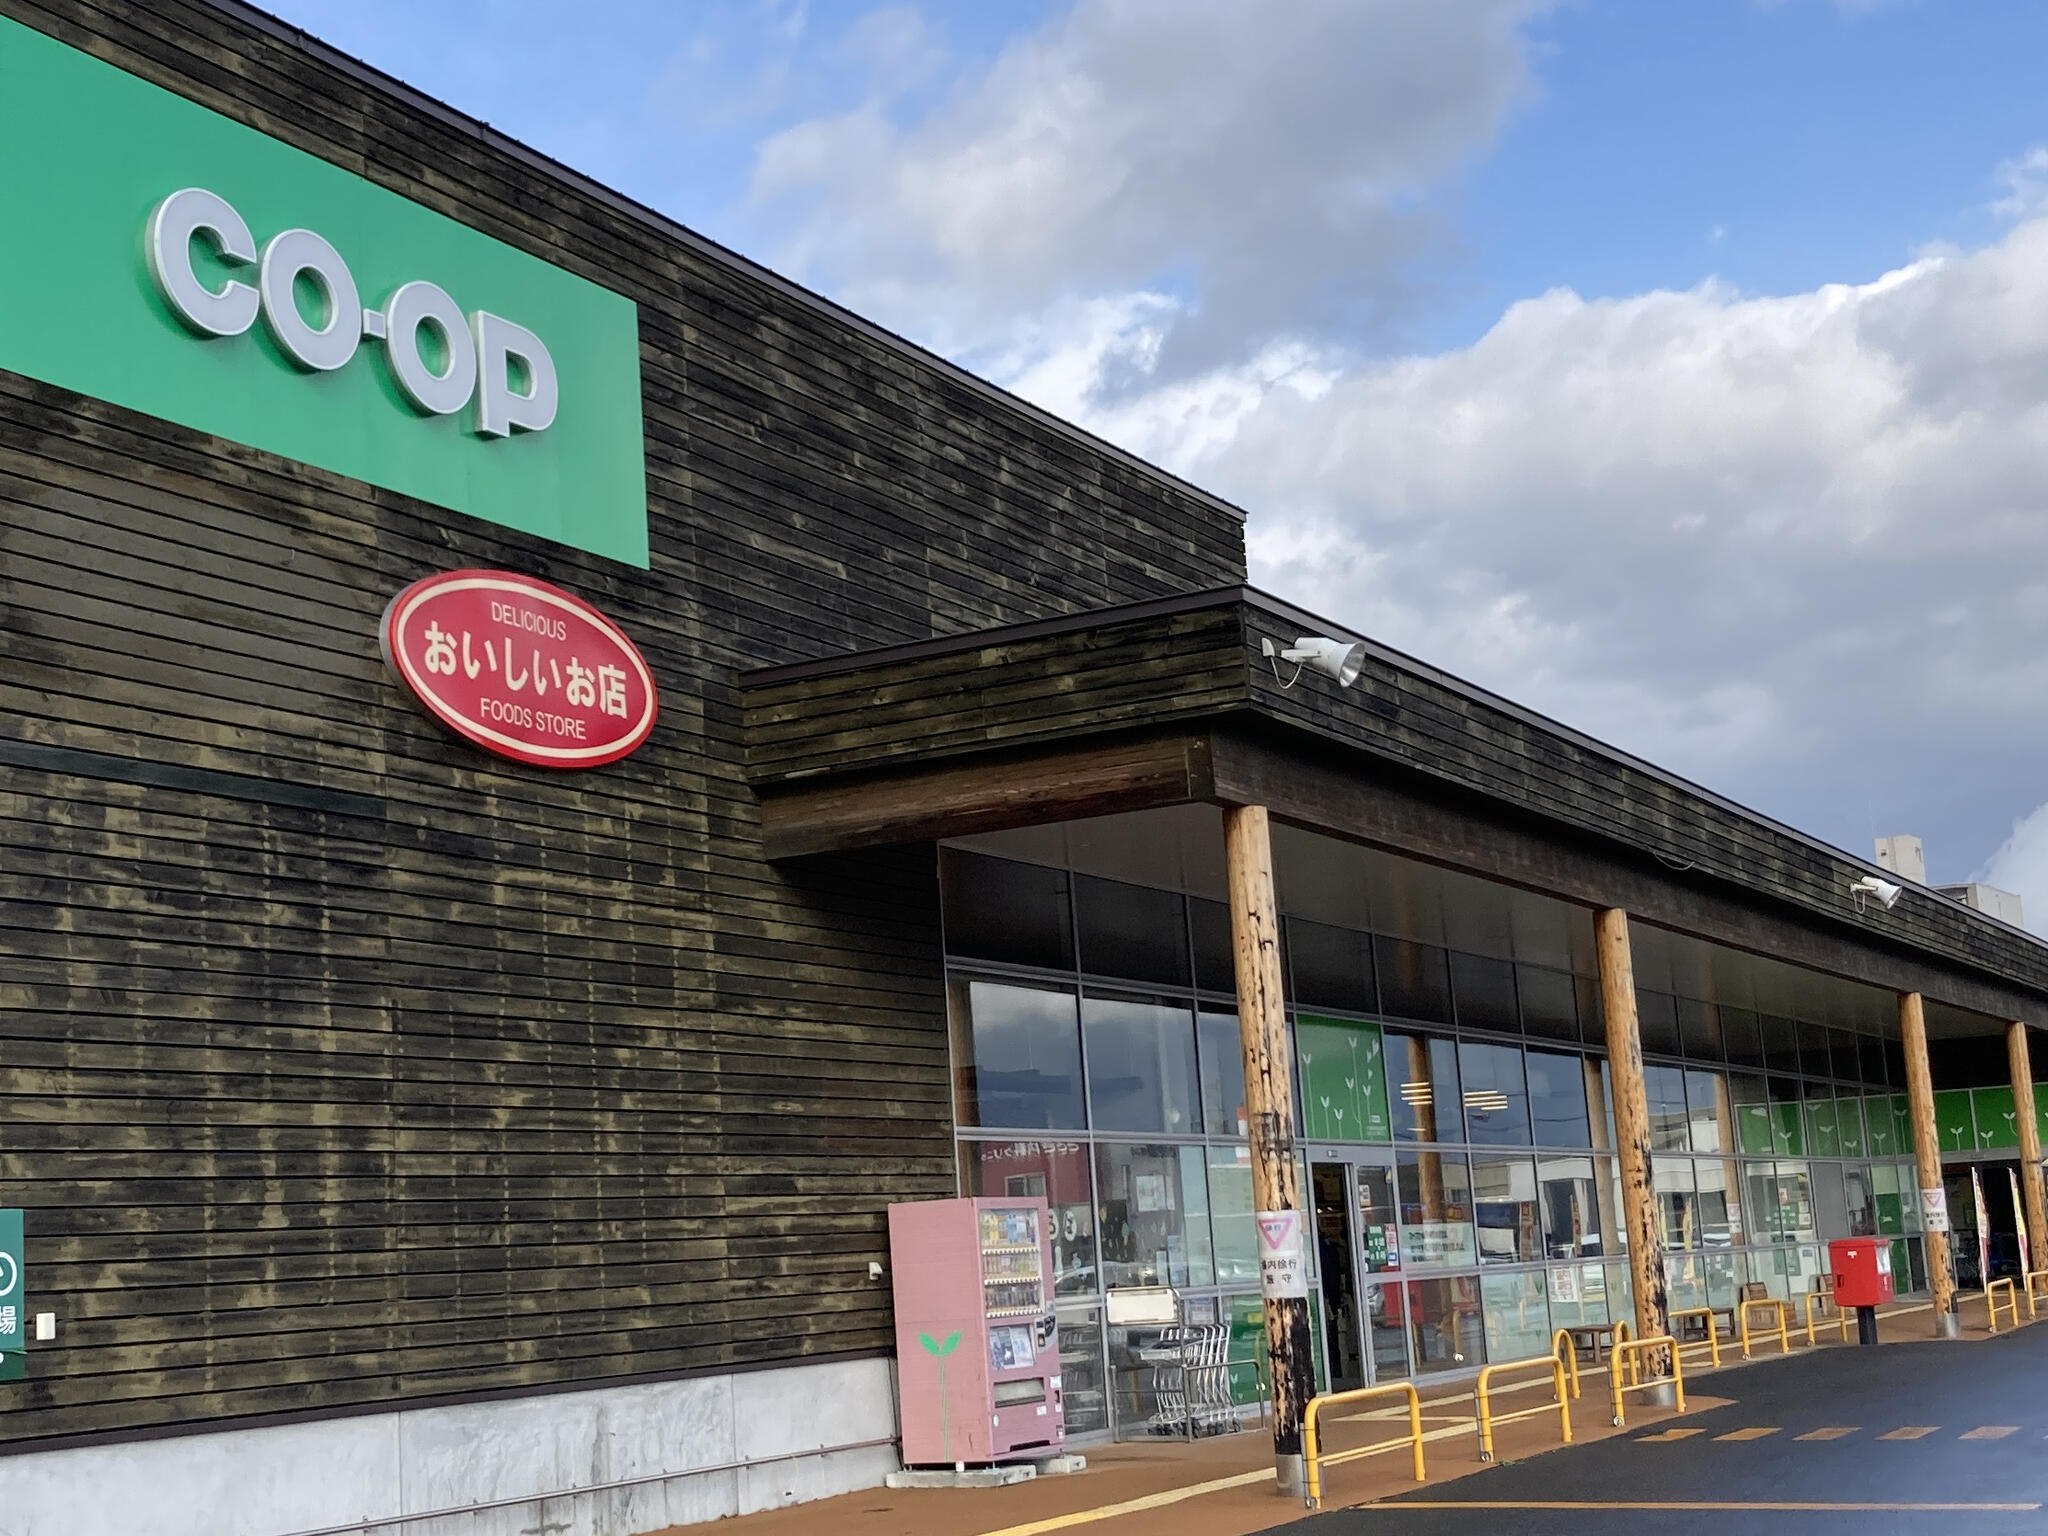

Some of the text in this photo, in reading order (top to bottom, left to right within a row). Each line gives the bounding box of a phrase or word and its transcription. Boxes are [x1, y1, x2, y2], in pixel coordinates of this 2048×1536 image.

[146, 187, 559, 437] CO-OP
[491, 601, 567, 641] DELICIOUS
[424, 620, 627, 719] おいしいお店
[480, 697, 587, 740] FOODS STORE
